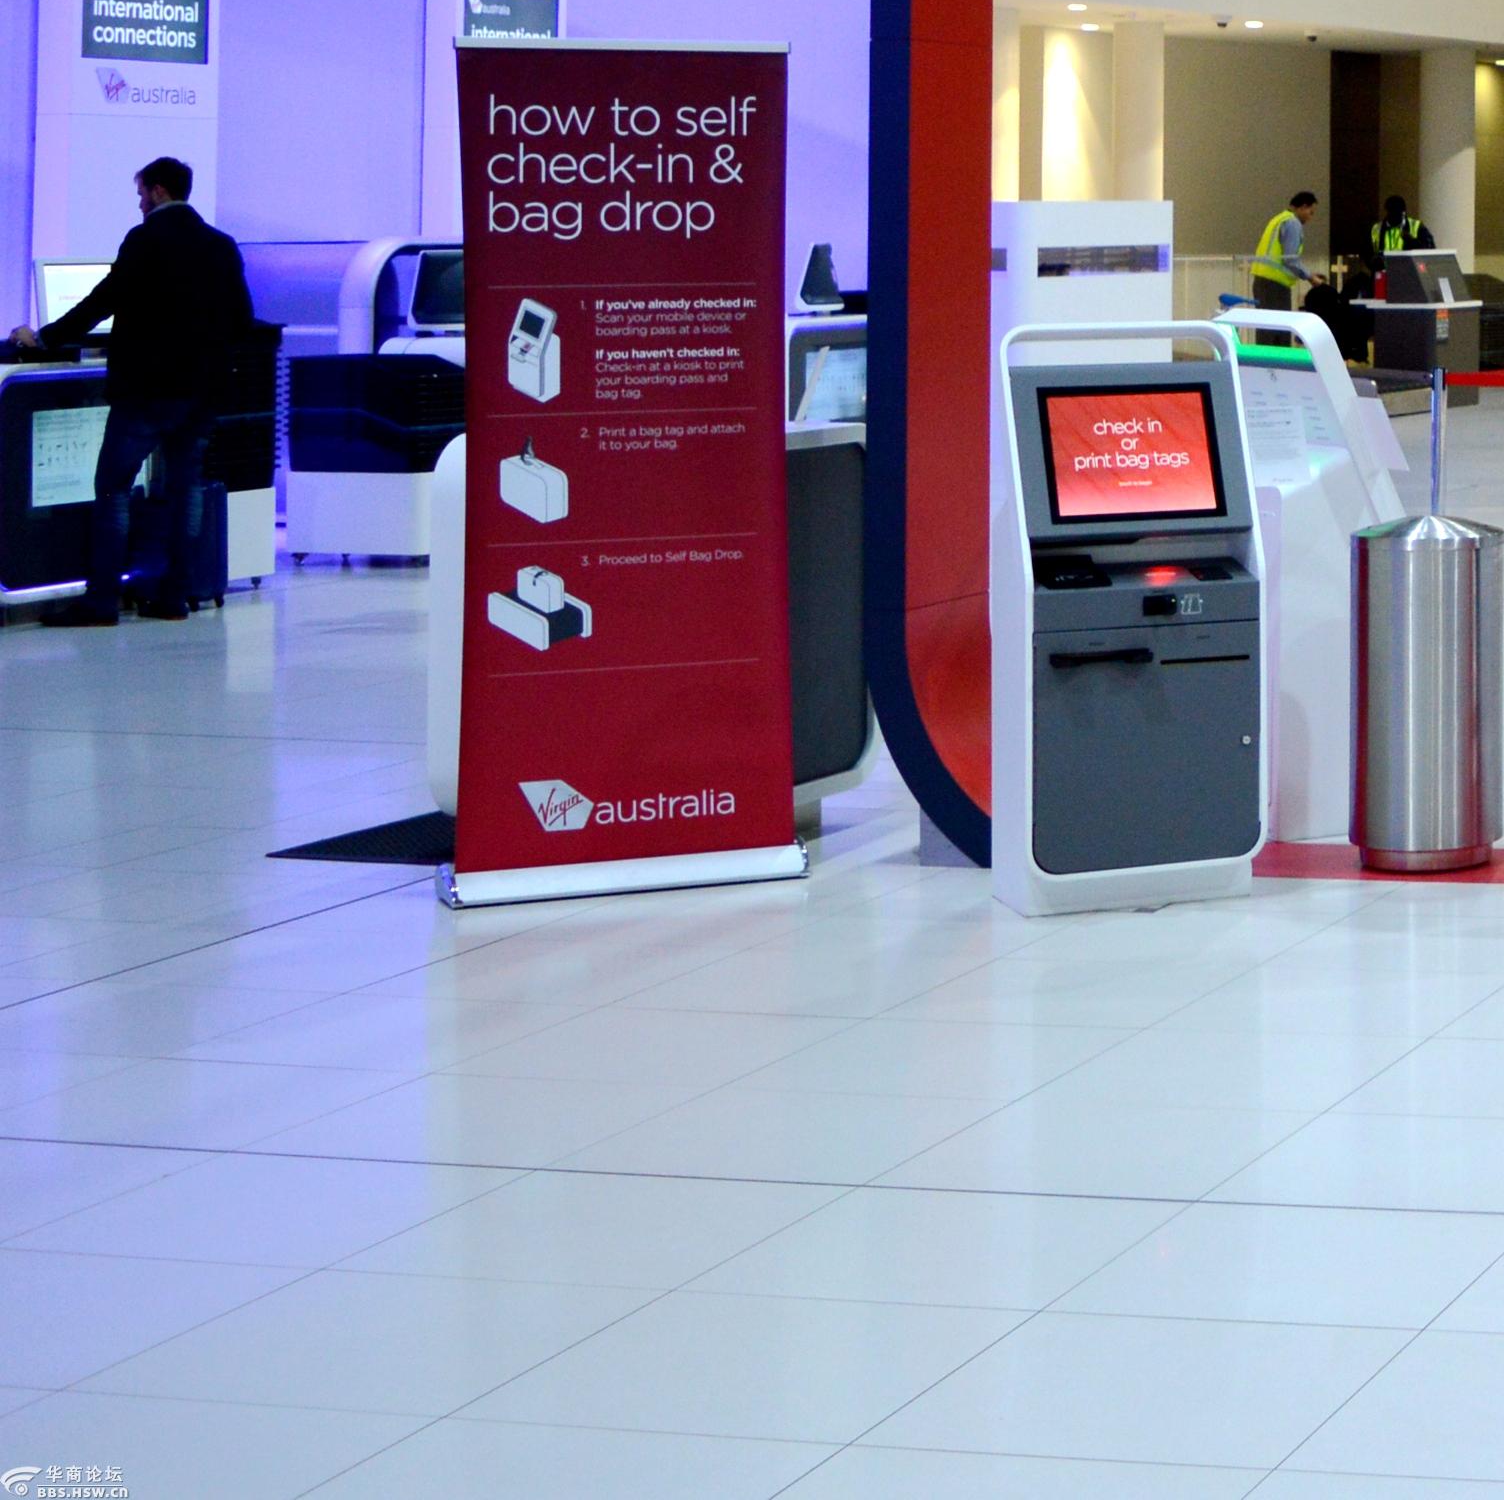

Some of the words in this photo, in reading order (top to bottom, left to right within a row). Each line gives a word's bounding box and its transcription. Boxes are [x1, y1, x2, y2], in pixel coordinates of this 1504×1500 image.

[93, 25, 197, 48] connections
[131, 86, 196, 105] australia
[489, 94, 595, 135] how
[611, 98, 661, 136] to
[675, 96, 756, 137] self
[487, 142, 693, 184] check-in
[709, 144, 744, 184] &
[489, 191, 582, 240] bag
[600, 190, 715, 239] drop
[595, 299, 604, 309] If
[607, 299, 645, 311] you've
[648, 298, 690, 310] already
[694, 297, 741, 308] checked
[743, 297, 757, 308] in:
[595, 313, 624, 323] Scan
[627, 314, 652, 324] your
[656, 312, 694, 322] mobile
[696, 311, 732, 321] device
[735, 312, 746, 321] or
[595, 326, 647, 337] boarding
[650, 327, 676, 336] pass
[679, 326, 690, 334] at
[595, 350, 603, 359] If
[607, 351, 629, 362] you
[632, 348, 674, 359] haven't
[677, 347, 724, 358] checked
[727, 347, 740, 357] in:
[595, 362, 647, 373] Check-in
[649, 362, 661, 371] at
[663, 363, 671, 371] a
[673, 361, 700, 371] kiosk
[704, 361, 715, 370] to
[719, 360, 744, 371] print
[595, 376, 621, 387] your
[625, 375, 676, 386] boarding
[679, 374, 704, 385] pass
[707, 374, 728, 383] and
[595, 389, 618, 400] bag
[598, 426, 626, 437] Print
[629, 428, 637, 436] a
[639, 425, 662, 437] bag
[664, 425, 684, 436] tag
[686, 424, 708, 434] and
[710, 423, 745, 433] attach
[1093, 418, 1143, 435] check
[1147, 417, 1162, 433] in
[599, 441, 606, 450] it
[609, 440, 622, 450] to
[625, 440, 650, 451] your
[1121, 437, 1139, 450] or
[1074, 452, 1111, 471] print
[1116, 451, 1149, 469] bag
[1153, 450, 1190, 467] tags
[598, 553, 647, 565] Proceed
[650, 552, 662, 563] to
[665, 551, 687, 562] Self
[689, 550, 711, 562] Bag
[537, 787, 584, 826] Virgin
[595, 788, 736, 825] australia
